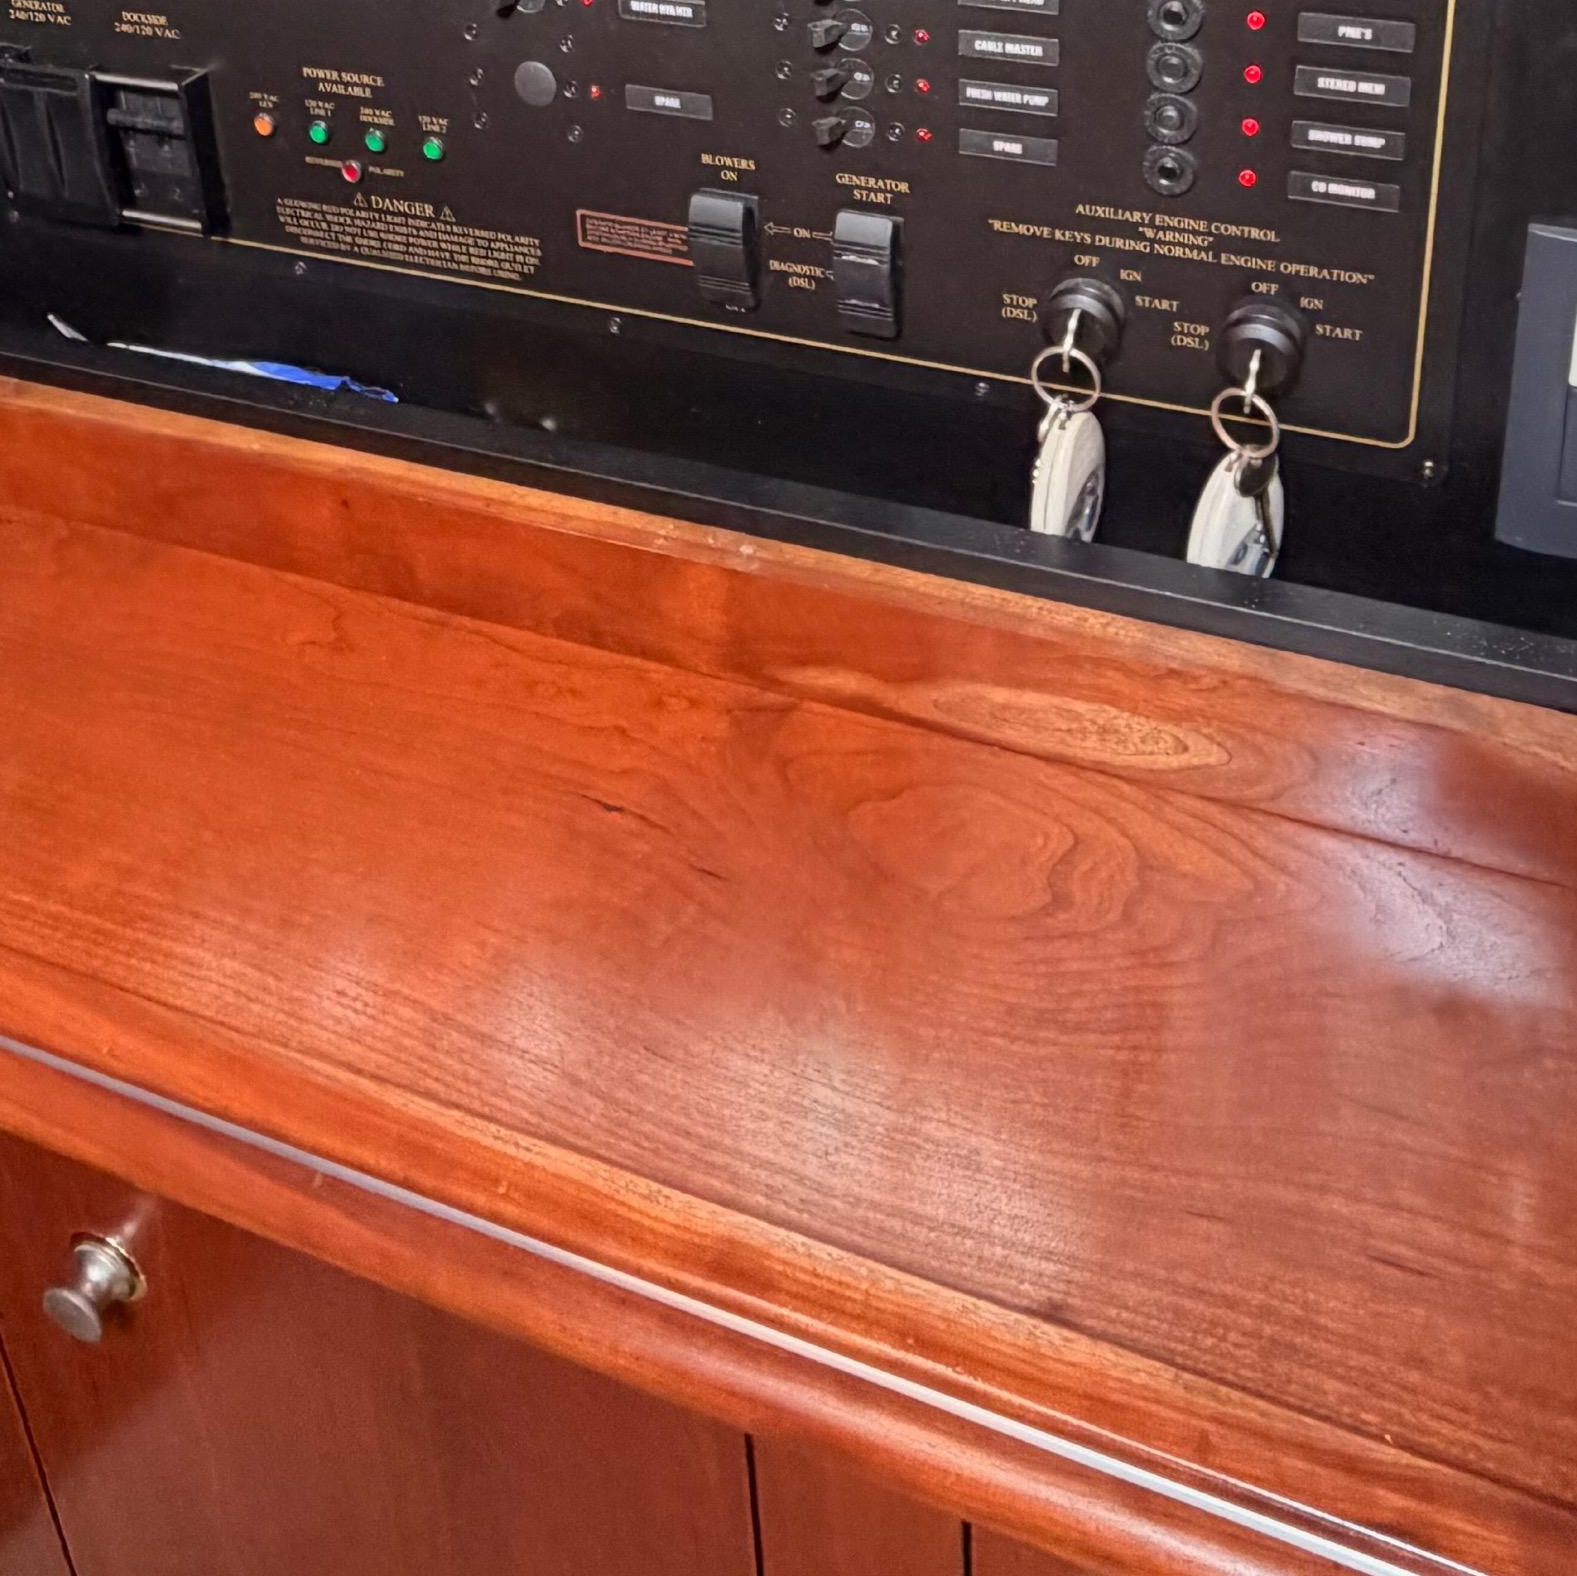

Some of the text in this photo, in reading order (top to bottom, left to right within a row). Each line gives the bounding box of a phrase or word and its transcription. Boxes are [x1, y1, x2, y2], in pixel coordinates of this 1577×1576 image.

[974, 39, 1043, 56] CABLE MASTER
[302, 66, 384, 86] POWER SOURCE
[318, 81, 372, 98] AVAILABLE
[701, 153, 755, 170] BLOWERS
[720, 169, 738, 181] ON
[835, 172, 910, 193] GENERATOR
[853, 188, 893, 204] START
[370, 195, 435, 218] DANGER
[1075, 203, 1280, 242] AUXILIARY ENGINE CONTROL
[793, 227, 812, 240] ON
[1138, 226, 1214, 247] "WARNING"
[988, 219, 1375, 284] "REMOVE KEYS DURING NORMAL ENGINE OPERATION"
[769, 260, 826, 278] DIAGNOSTIC
[1073, 254, 1100, 267] OFF
[788, 275, 816, 290] (DSL)
[1119, 268, 1142, 282] IGN
[1251, 281, 1279, 295] OFF
[1002, 293, 1037, 308] STOP
[1135, 295, 1179, 312] START
[1300, 296, 1323, 310] IGN
[1001, 306, 1038, 322] (DSL)
[1173, 321, 1210, 336] STOP
[1315, 324, 1363, 341] START
[1170, 334, 1209, 351] (DSL)
